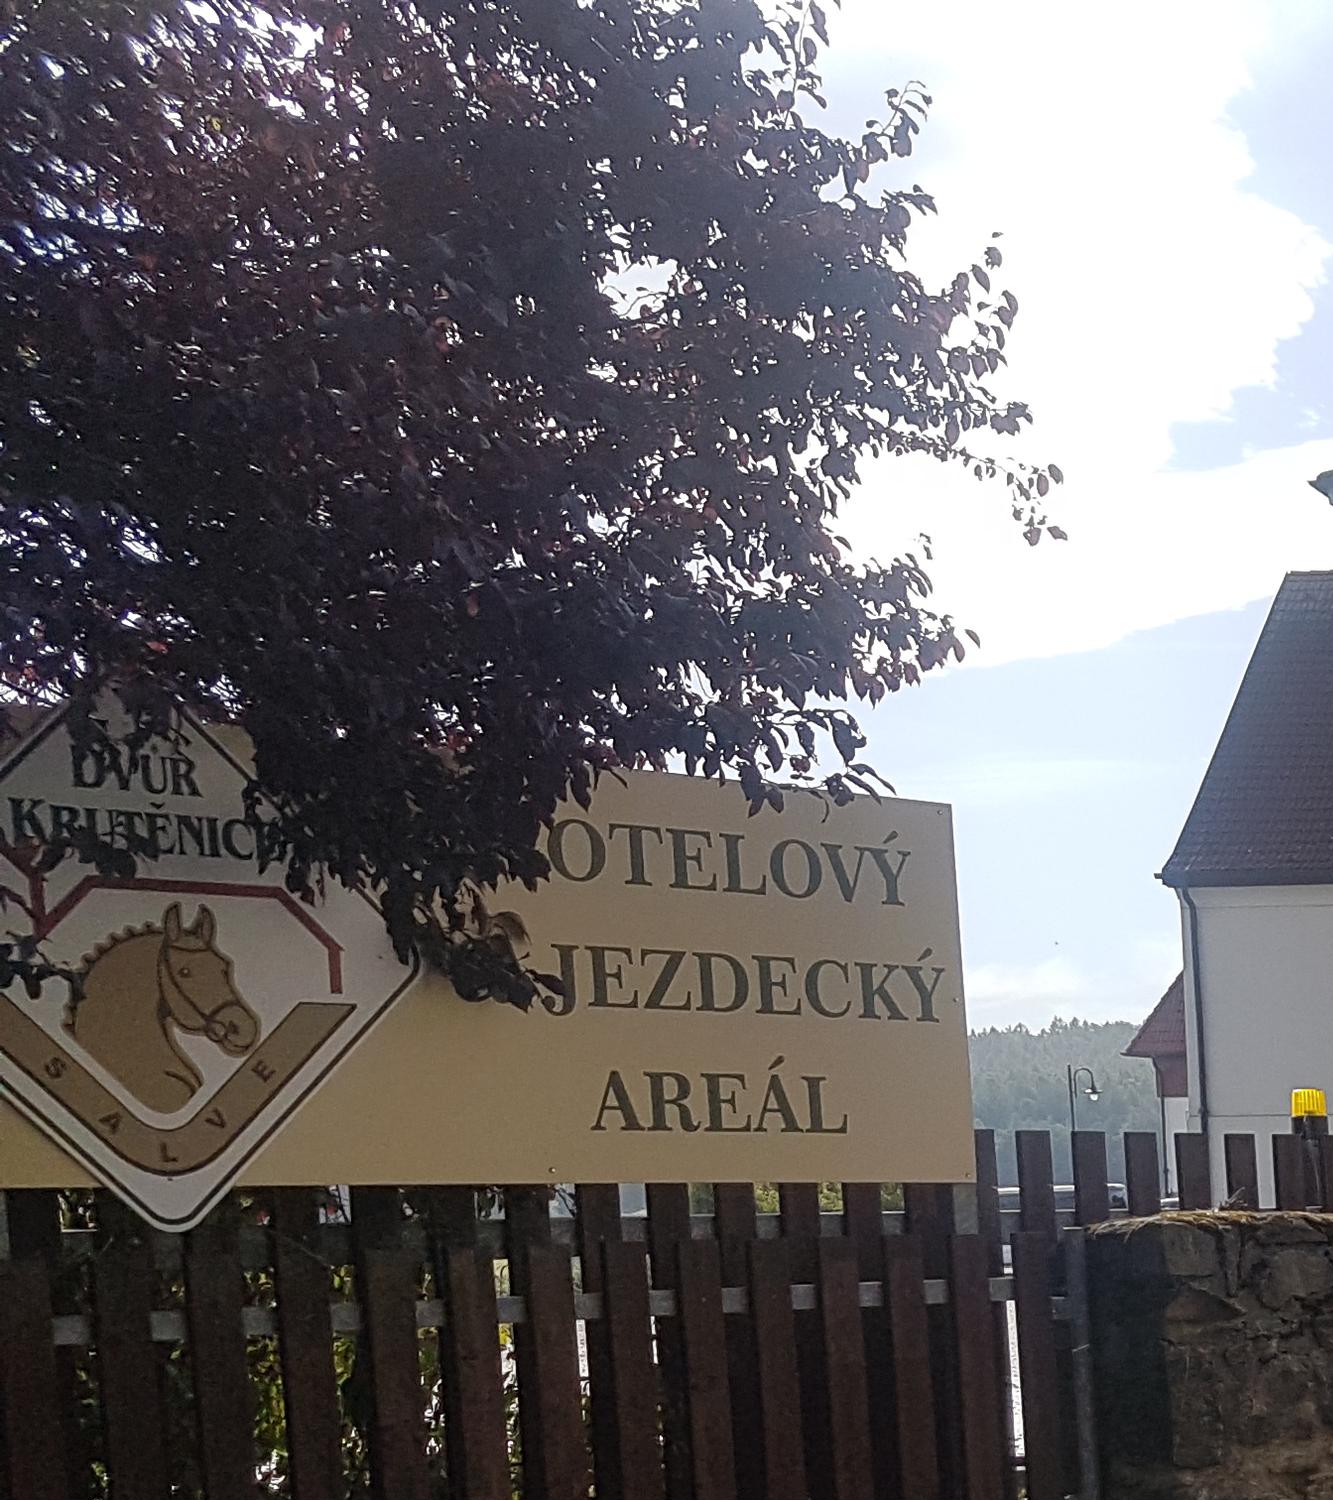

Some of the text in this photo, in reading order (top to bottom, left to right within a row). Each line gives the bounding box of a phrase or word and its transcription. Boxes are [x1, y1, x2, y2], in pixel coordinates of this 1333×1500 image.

[547, 818, 911, 906] OTELOVÝ
[541, 947, 946, 1023] JEZDECKÝ
[590, 1055, 848, 1134] AREÁL
